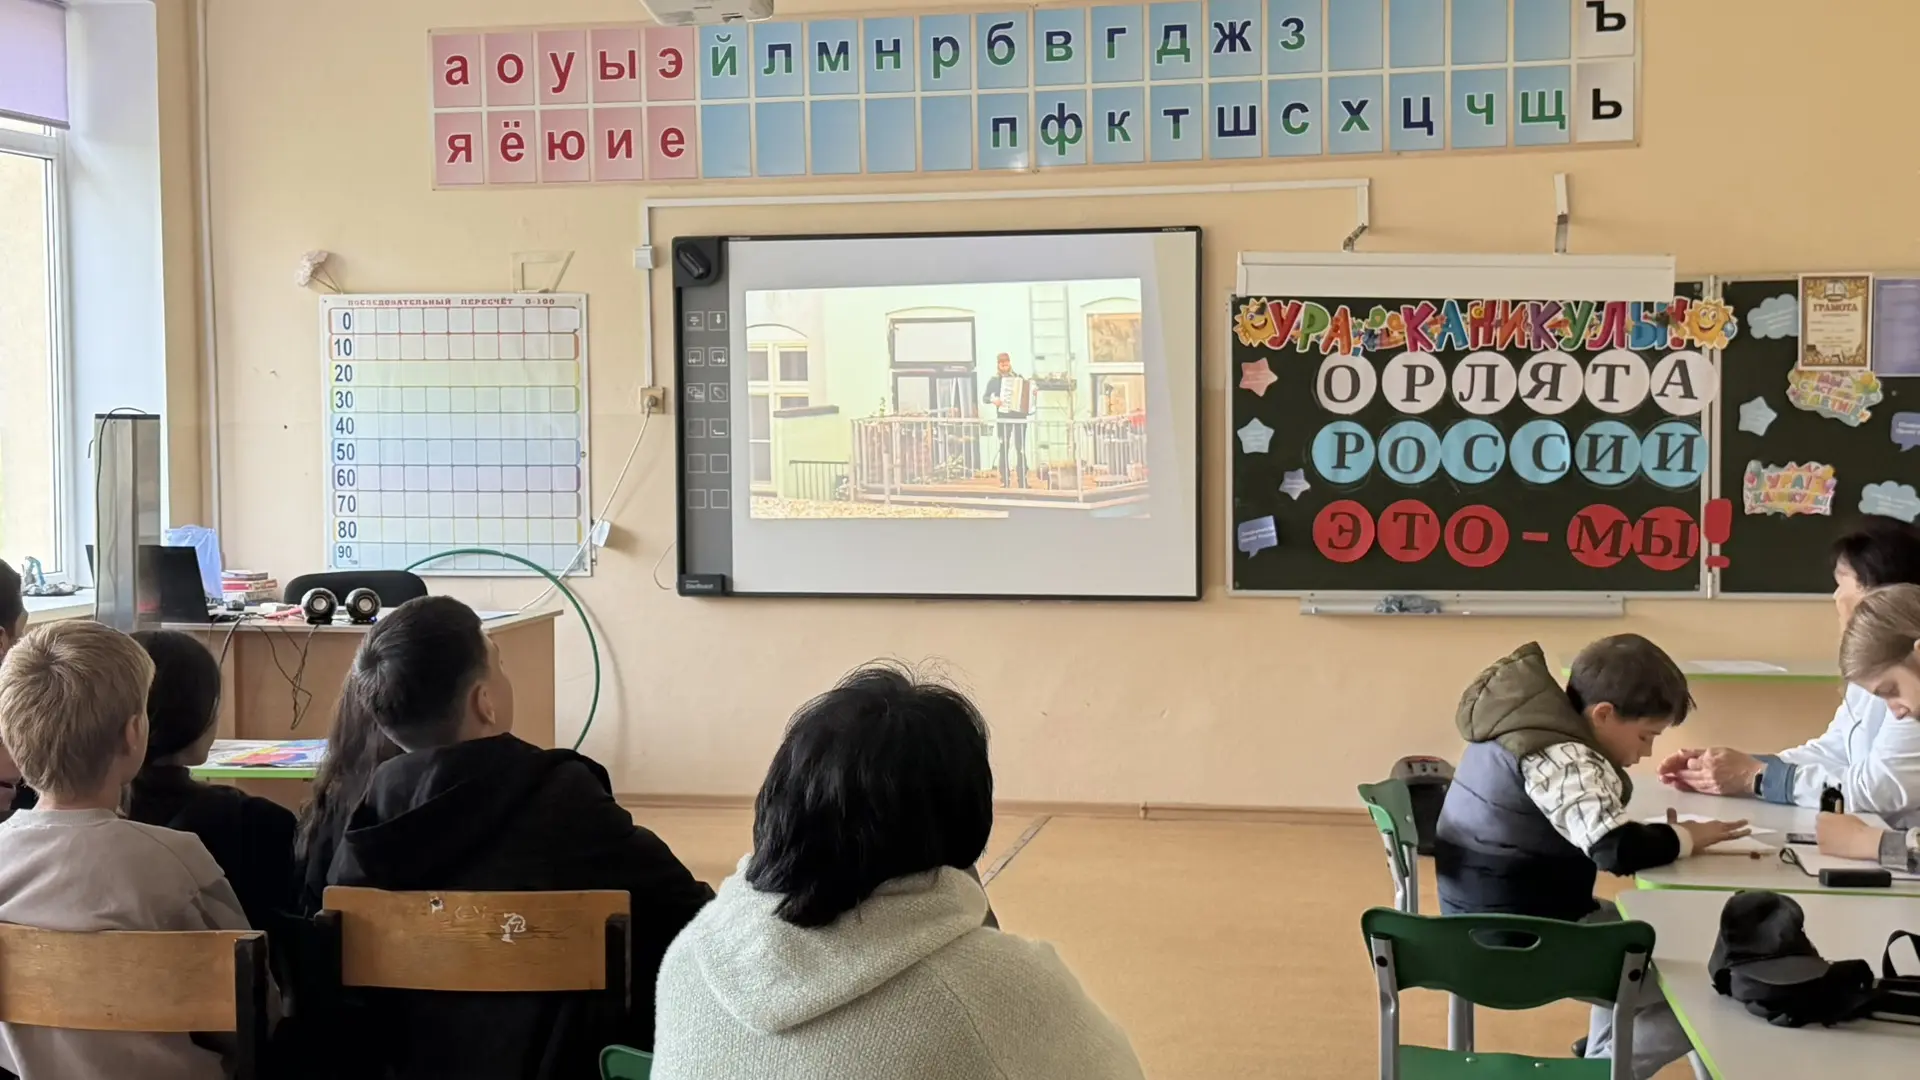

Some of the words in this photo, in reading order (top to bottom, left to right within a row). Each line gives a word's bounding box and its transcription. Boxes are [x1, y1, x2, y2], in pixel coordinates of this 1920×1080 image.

[445, 55, 469, 86] а
[549, 52, 575, 93] у
[599, 50, 636, 80] ы
[658, 48, 683, 79] э
[712, 34, 737, 77] й
[763, 43, 792, 75] л
[817, 40, 849, 72] м
[875, 38, 901, 70] н
[932, 36, 960, 79] р
[986, 21, 1015, 65] б
[1106, 27, 1127, 59] г
[1156, 24, 1191, 64] д
[447, 134, 472, 163] я
[500, 121, 525, 162] ё
[547, 130, 585, 161] ю
[607, 129, 632, 159] и
[660, 127, 685, 158] е
[992, 116, 1017, 148] п
[1040, 102, 1083, 156] ф
[1163, 108, 1190, 139] т
[1402, 96, 1434, 136] ц
[1466, 93, 1494, 125] ч
[1521, 90, 1566, 130] щ
[1592, 87, 1623, 120] ь
[348, 298, 451, 307] ПОСЛЕДОВАТЕЛЬНЫЙ
[461, 297, 514, 306] ПЕРЕСЧЁТ
[1812, 303, 1859, 312] ГРАМОТА
[342, 311, 352, 331] 0
[1401, 298, 1688, 352] КАНИКУЛЫ!
[334, 338, 353, 356] 10
[334, 364, 353, 382] 20
[1323, 359, 1699, 403] ОРЛЯТА
[335, 390, 354, 409] 30
[335, 416, 355, 435] 40
[336, 442, 355, 461] 50
[1330, 432, 1700, 475] РОССИИ
[336, 468, 356, 487] 60
[337, 494, 357, 513] 70
[338, 520, 357, 539] 80
[1327, 511, 1494, 554] ЭТО
[338, 545, 352, 559] 90
